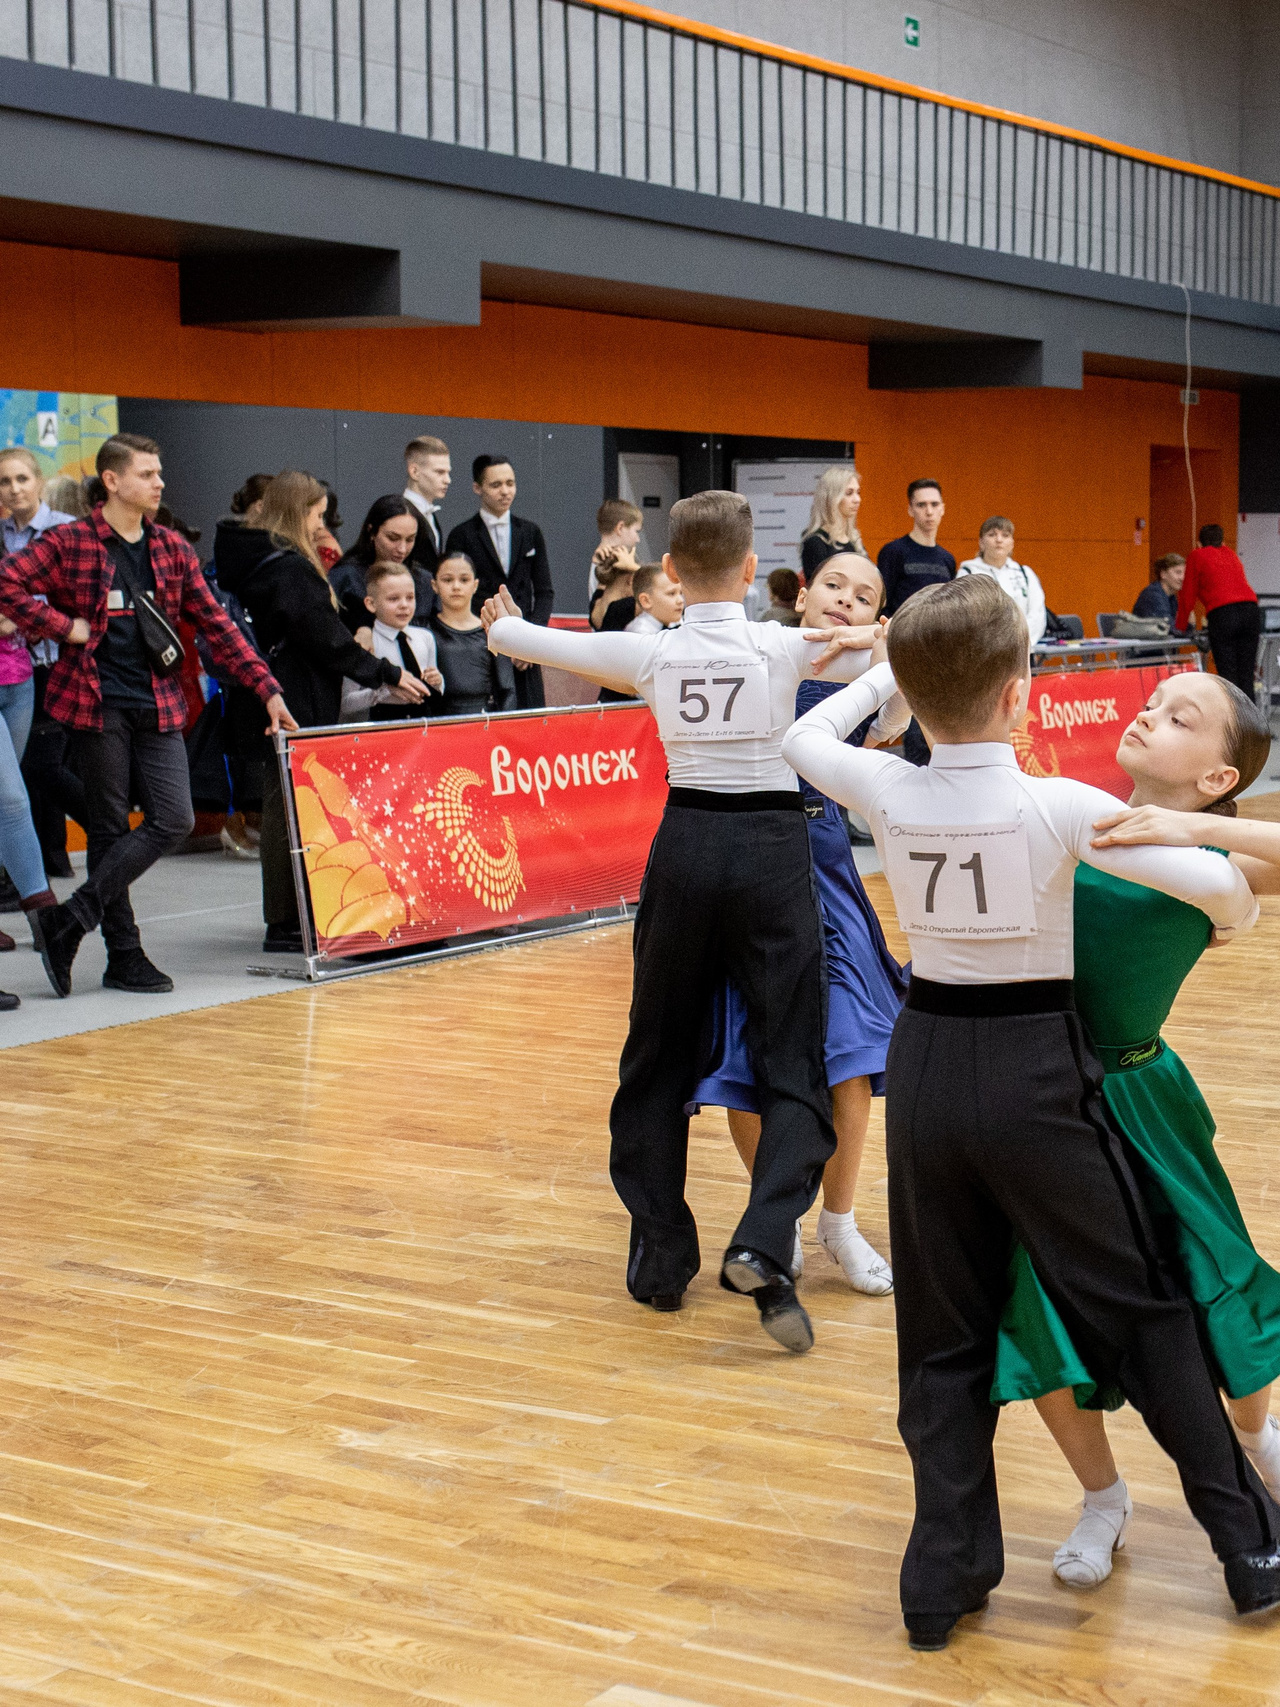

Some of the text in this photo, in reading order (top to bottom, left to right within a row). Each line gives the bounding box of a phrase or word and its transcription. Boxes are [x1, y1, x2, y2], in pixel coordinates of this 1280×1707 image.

[679, 677, 745, 723] 57
[1039, 693, 1119, 738] Воронеж
[490, 745, 639, 807] Воронеж
[909, 851, 988, 914] 71
[928, 925, 967, 934] Открытый
[968, 925, 1021, 935] Европейская
